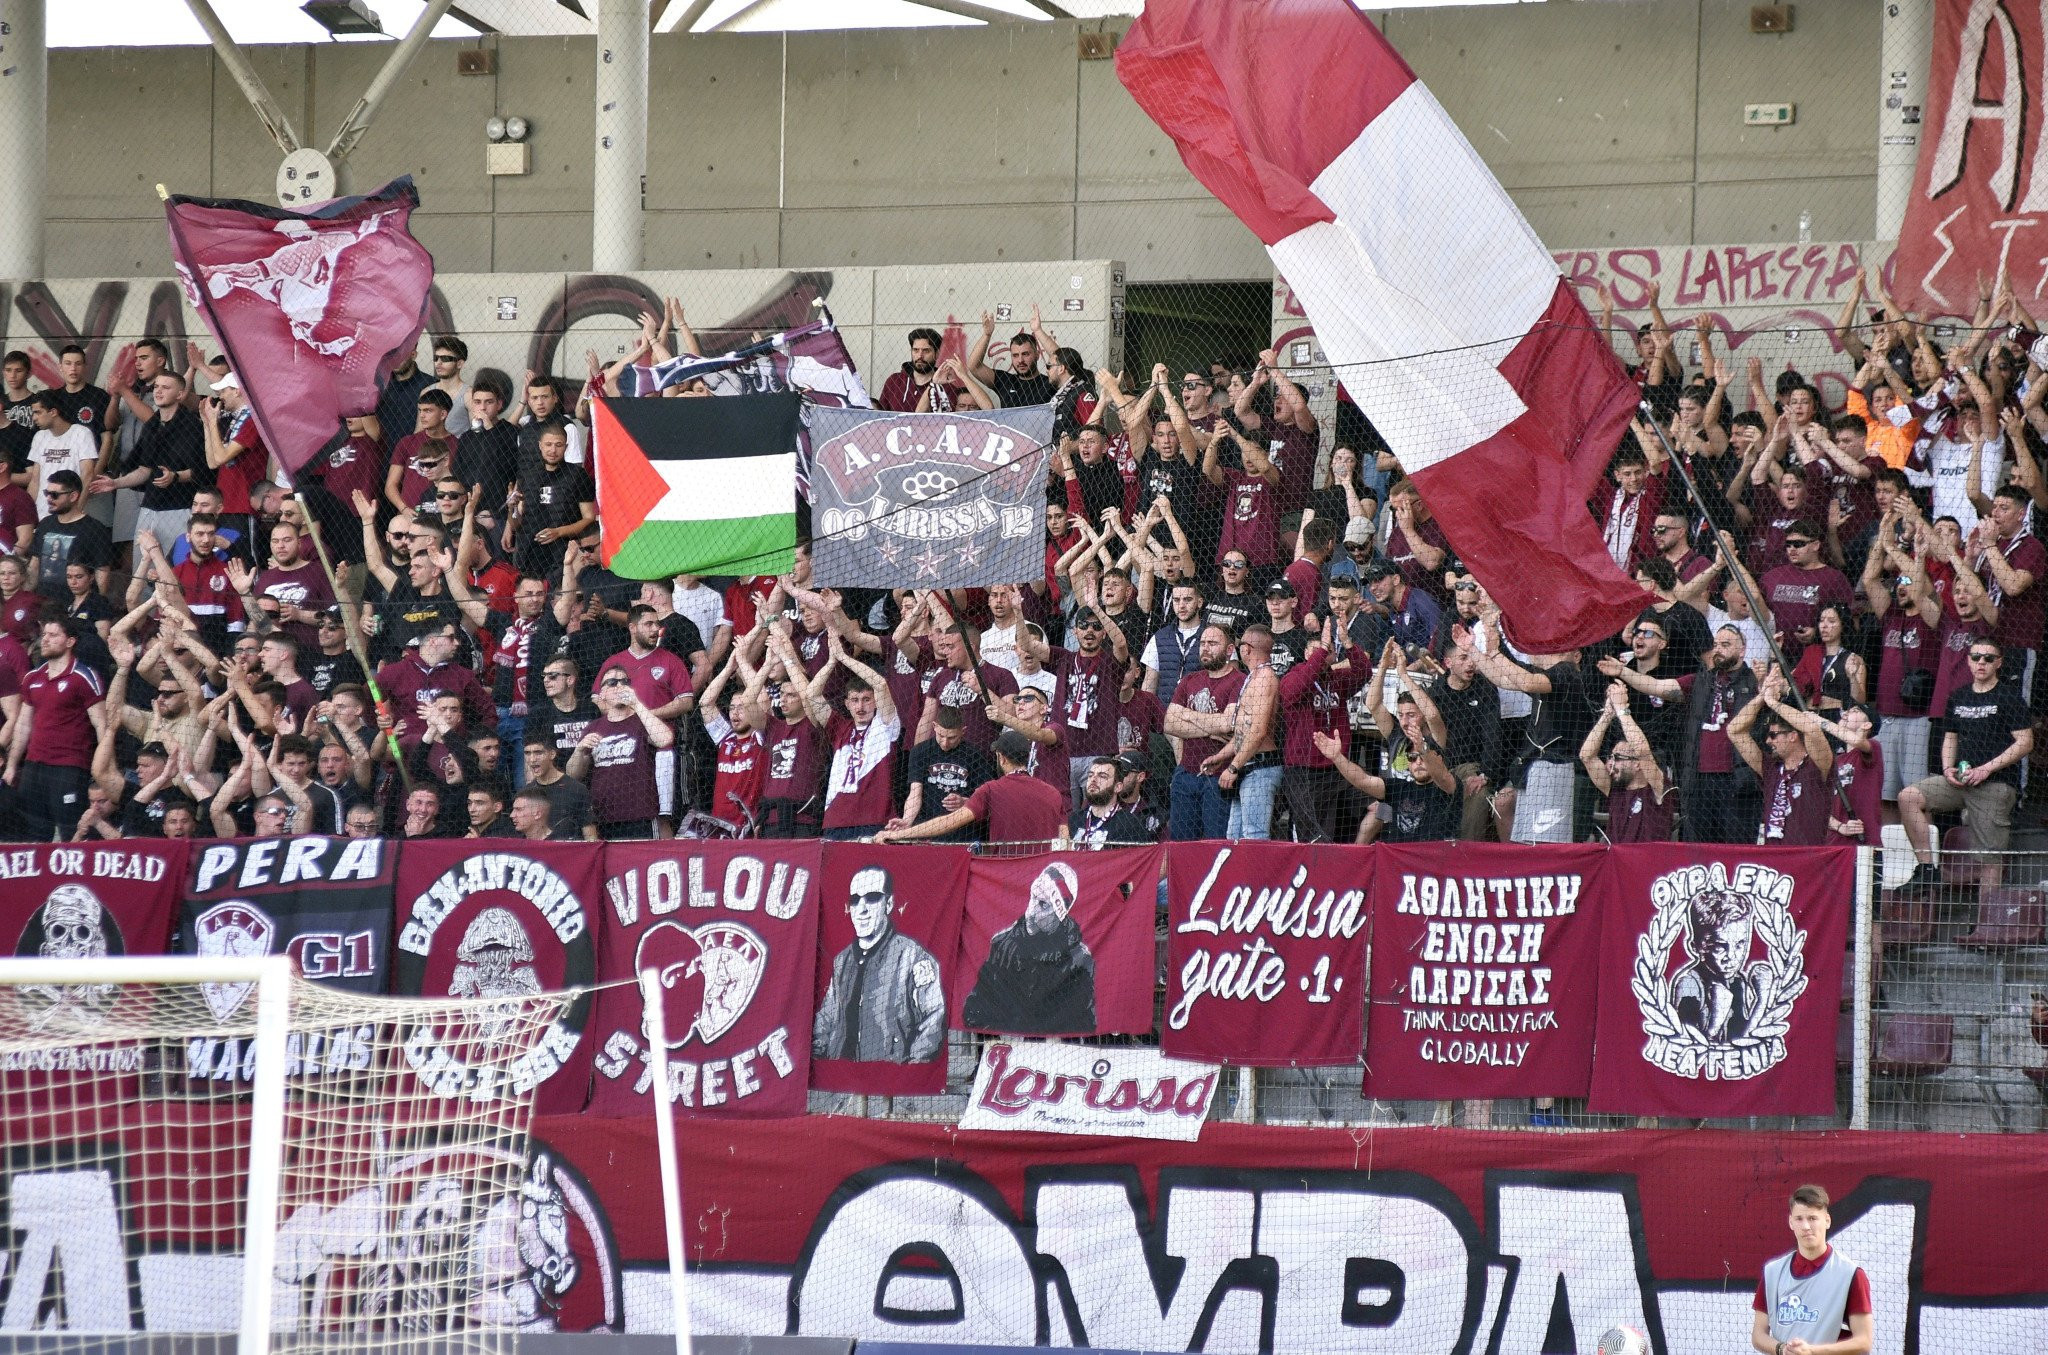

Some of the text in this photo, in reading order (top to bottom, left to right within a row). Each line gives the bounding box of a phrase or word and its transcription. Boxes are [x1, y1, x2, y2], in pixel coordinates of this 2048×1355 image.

[1675, 244, 1870, 305] LARISSA
[844, 424, 1021, 475] A.C.A.B.
[821, 495, 1034, 540] 06 LARISSA 12
[1206, 604, 1248, 617] MONSTERS
[1537, 808, 1562, 824] NIKE
[50, 849, 86, 876] OR
[92, 850, 165, 882] DEAD
[196, 837, 382, 892] PERA
[1650, 863, 1794, 910] ΘΥΡΑ ΕΝΑ
[606, 857, 810, 926] VOLOU
[1177, 848, 1367, 939] Larissa
[1397, 874, 1581, 918] ΑΘΛΗΤΙΚΗ
[287, 931, 375, 978] G1
[1423, 922, 1545, 964] ΕΝΩΣΗ
[1168, 937, 1287, 1030] gate
[1410, 968, 1552, 1006] ΛΑΡΙΣΑΣ
[595, 1027, 794, 1108] STREET
[1421, 1038, 1530, 1068] GLOBALLY
[1644, 1034, 1788, 1080] ΝΕΑ ΓΕΝΙΑ
[977, 1043, 1219, 1119] Larissa
